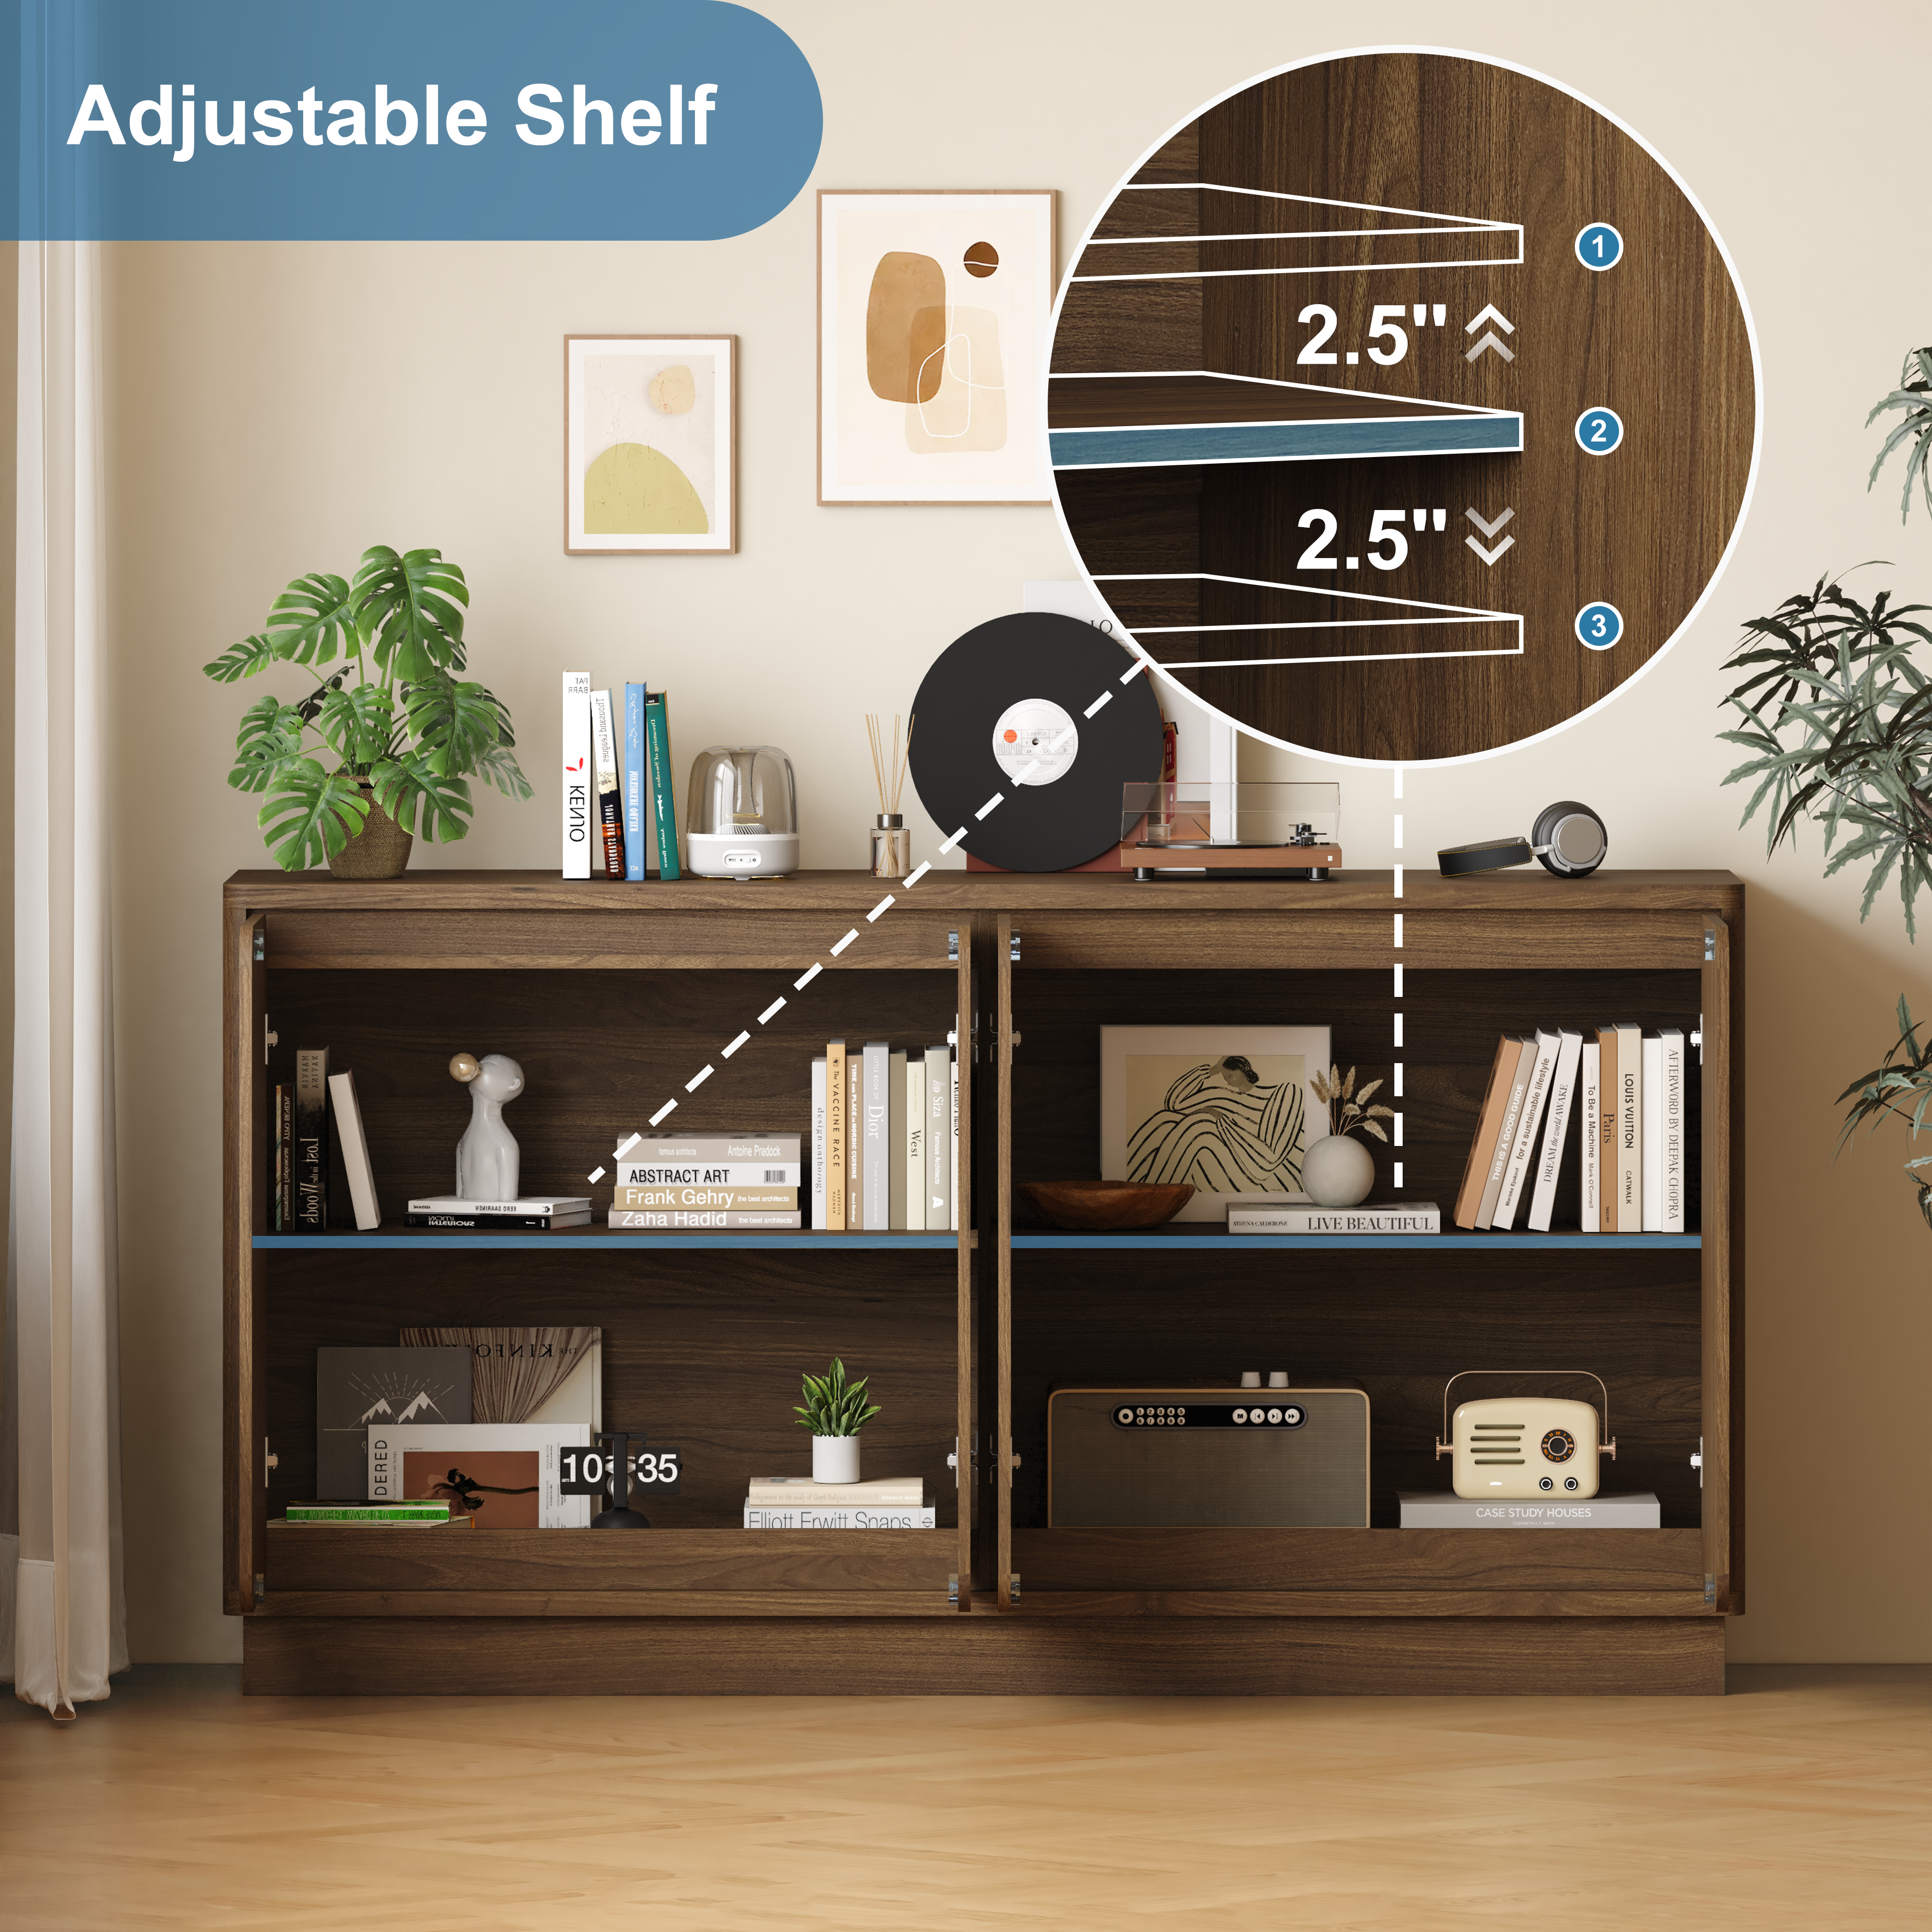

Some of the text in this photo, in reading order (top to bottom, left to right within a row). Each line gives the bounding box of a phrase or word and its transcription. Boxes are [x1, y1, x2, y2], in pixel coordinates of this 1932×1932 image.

[1588, 1085, 1595, 1096] To
[933, 1096, 944, 1117] Siza
[1516, 1148, 1525, 1160] for
[1523, 1091, 1540, 1139] sustainable
[1535, 1058, 1549, 1090] lifestyle
[1588, 1098, 1595, 1110] Be
[1625, 1074, 1633, 1148] LOUIS VUITTON
[816, 1108, 824, 1140] design
[868, 1105, 884, 1139] Dior
[1492, 1160, 1503, 1181] THIS
[1499, 1151, 1506, 1160] IS
[1504, 1114, 1516, 1140] GOOD
[1511, 1084, 1524, 1112] GUIDE
[1604, 1113, 1615, 1143] Paris
[910, 1129, 921, 1158] West
[1543, 1084, 1568, 1182] DREAM the world AWAKE
[1669, 1049, 1679, 1219] AFTERWORD BY DEEPAK CHOPRA
[659, 1147, 697, 1156] famous architects
[728, 1145, 781, 1157] Antoine Predock
[629, 1170, 730, 1182] ABSTRACT ART
[1505, 1167, 1519, 1206] Marieke Eyskoot
[627, 1189, 734, 1208] Frank Gehry
[932, 1196, 943, 1208] A
[622, 1212, 726, 1226] Zaha Hadid
[1308, 1217, 1433, 1230] LIVE BEAUTIFUL
[563, 1453, 603, 1483] 10
[638, 1453, 678, 1483] 35
[828, 1494, 846, 1503] Religion
[749, 1512, 793, 1528] Elliott
[800, 1512, 848, 1528] Erwitt
[1476, 1508, 1591, 1517] CASE STUDY HOUSES
